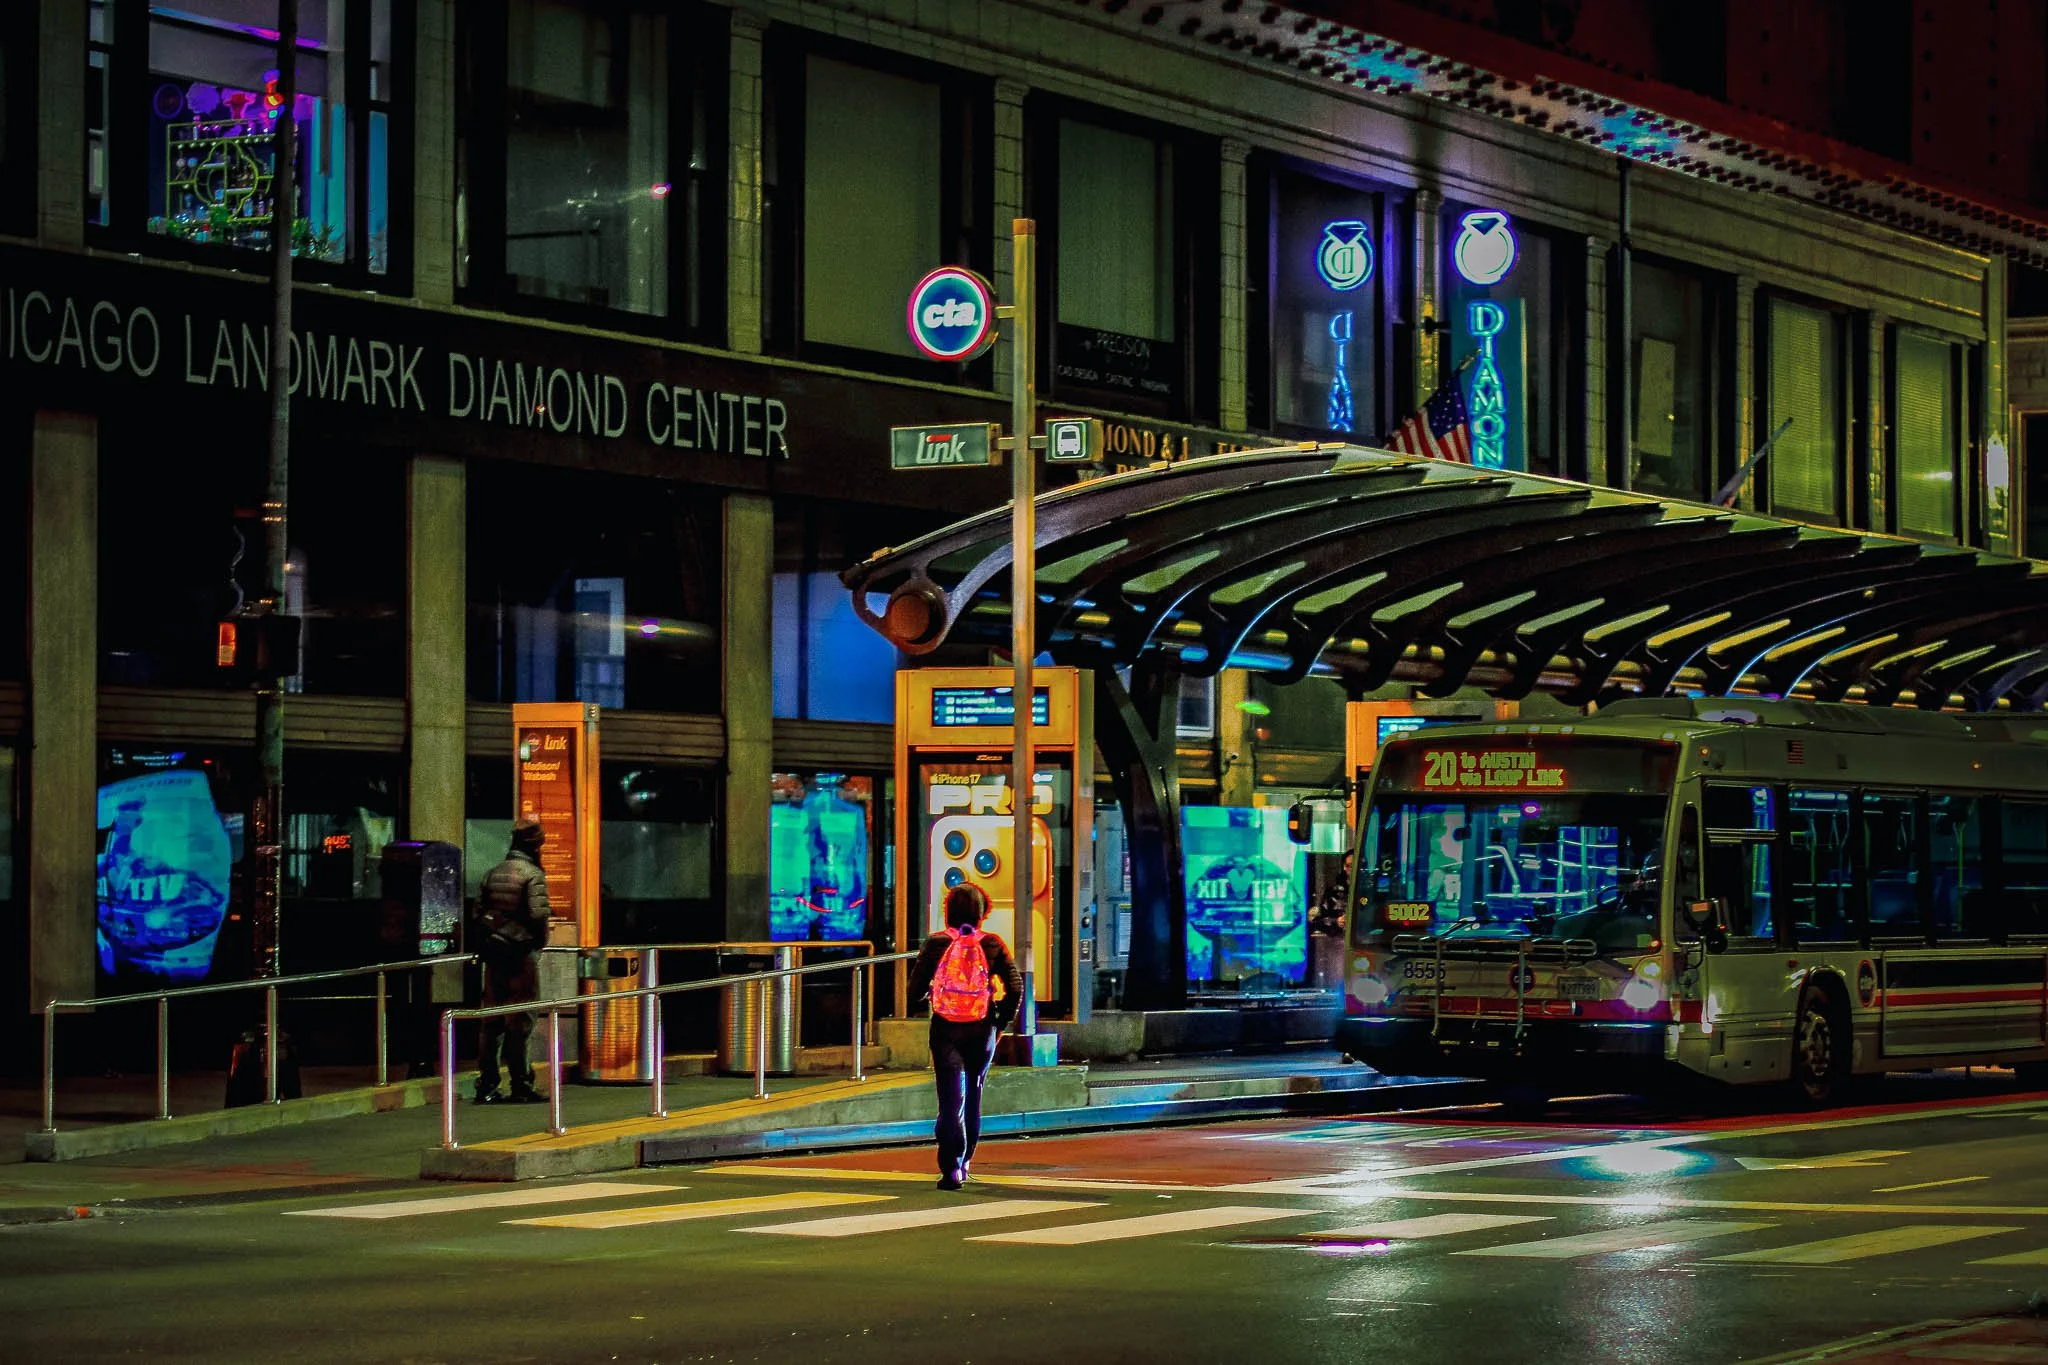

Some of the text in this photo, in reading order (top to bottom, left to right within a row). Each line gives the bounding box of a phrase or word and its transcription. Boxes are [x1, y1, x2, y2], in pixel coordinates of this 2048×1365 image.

[923, 299, 978, 329] cta
[185, 314, 425, 411] LANDMARK
[449, 352, 628, 438] DIAMOND
[646, 382, 790, 459] CENTER
[938, 774, 981, 784] iPhone 17
[1425, 752, 1535, 786] 20 to AUSTIN
[1460, 769, 1564, 786] via LOOP LINK
[930, 784, 1053, 815] PRO
[1404, 961, 1446, 980] 8555
